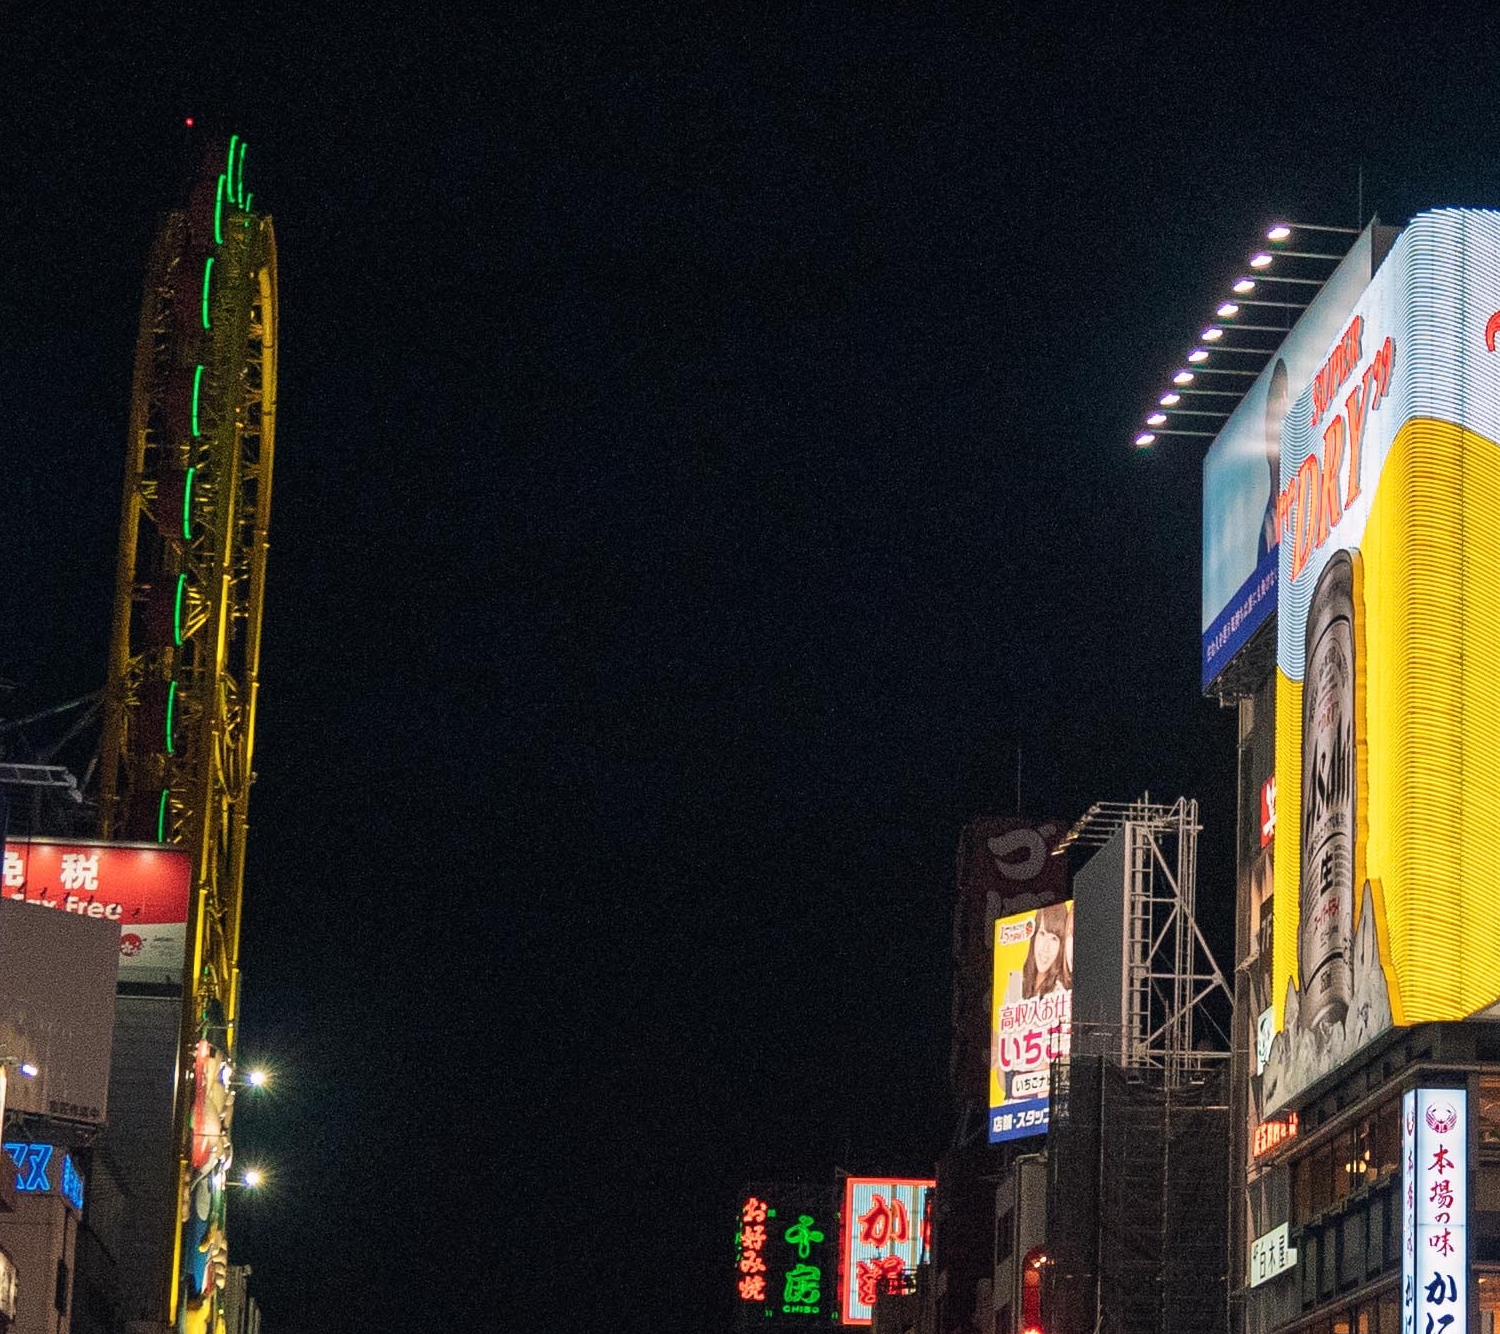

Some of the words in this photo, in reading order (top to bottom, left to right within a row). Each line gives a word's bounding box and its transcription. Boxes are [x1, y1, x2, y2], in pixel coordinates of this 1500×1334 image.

[1311, 315, 1365, 428] SUPER
[66, 896, 123, 921] Free
[1000, 995, 1072, 1031] 高収入お仕
[1426, 1143, 1455, 1258] 本場の味
[738, 1197, 768, 1302] お好み焼
[782, 1215, 824, 1305] 千房
[1258, 1235, 1290, 1279] 白木屋
